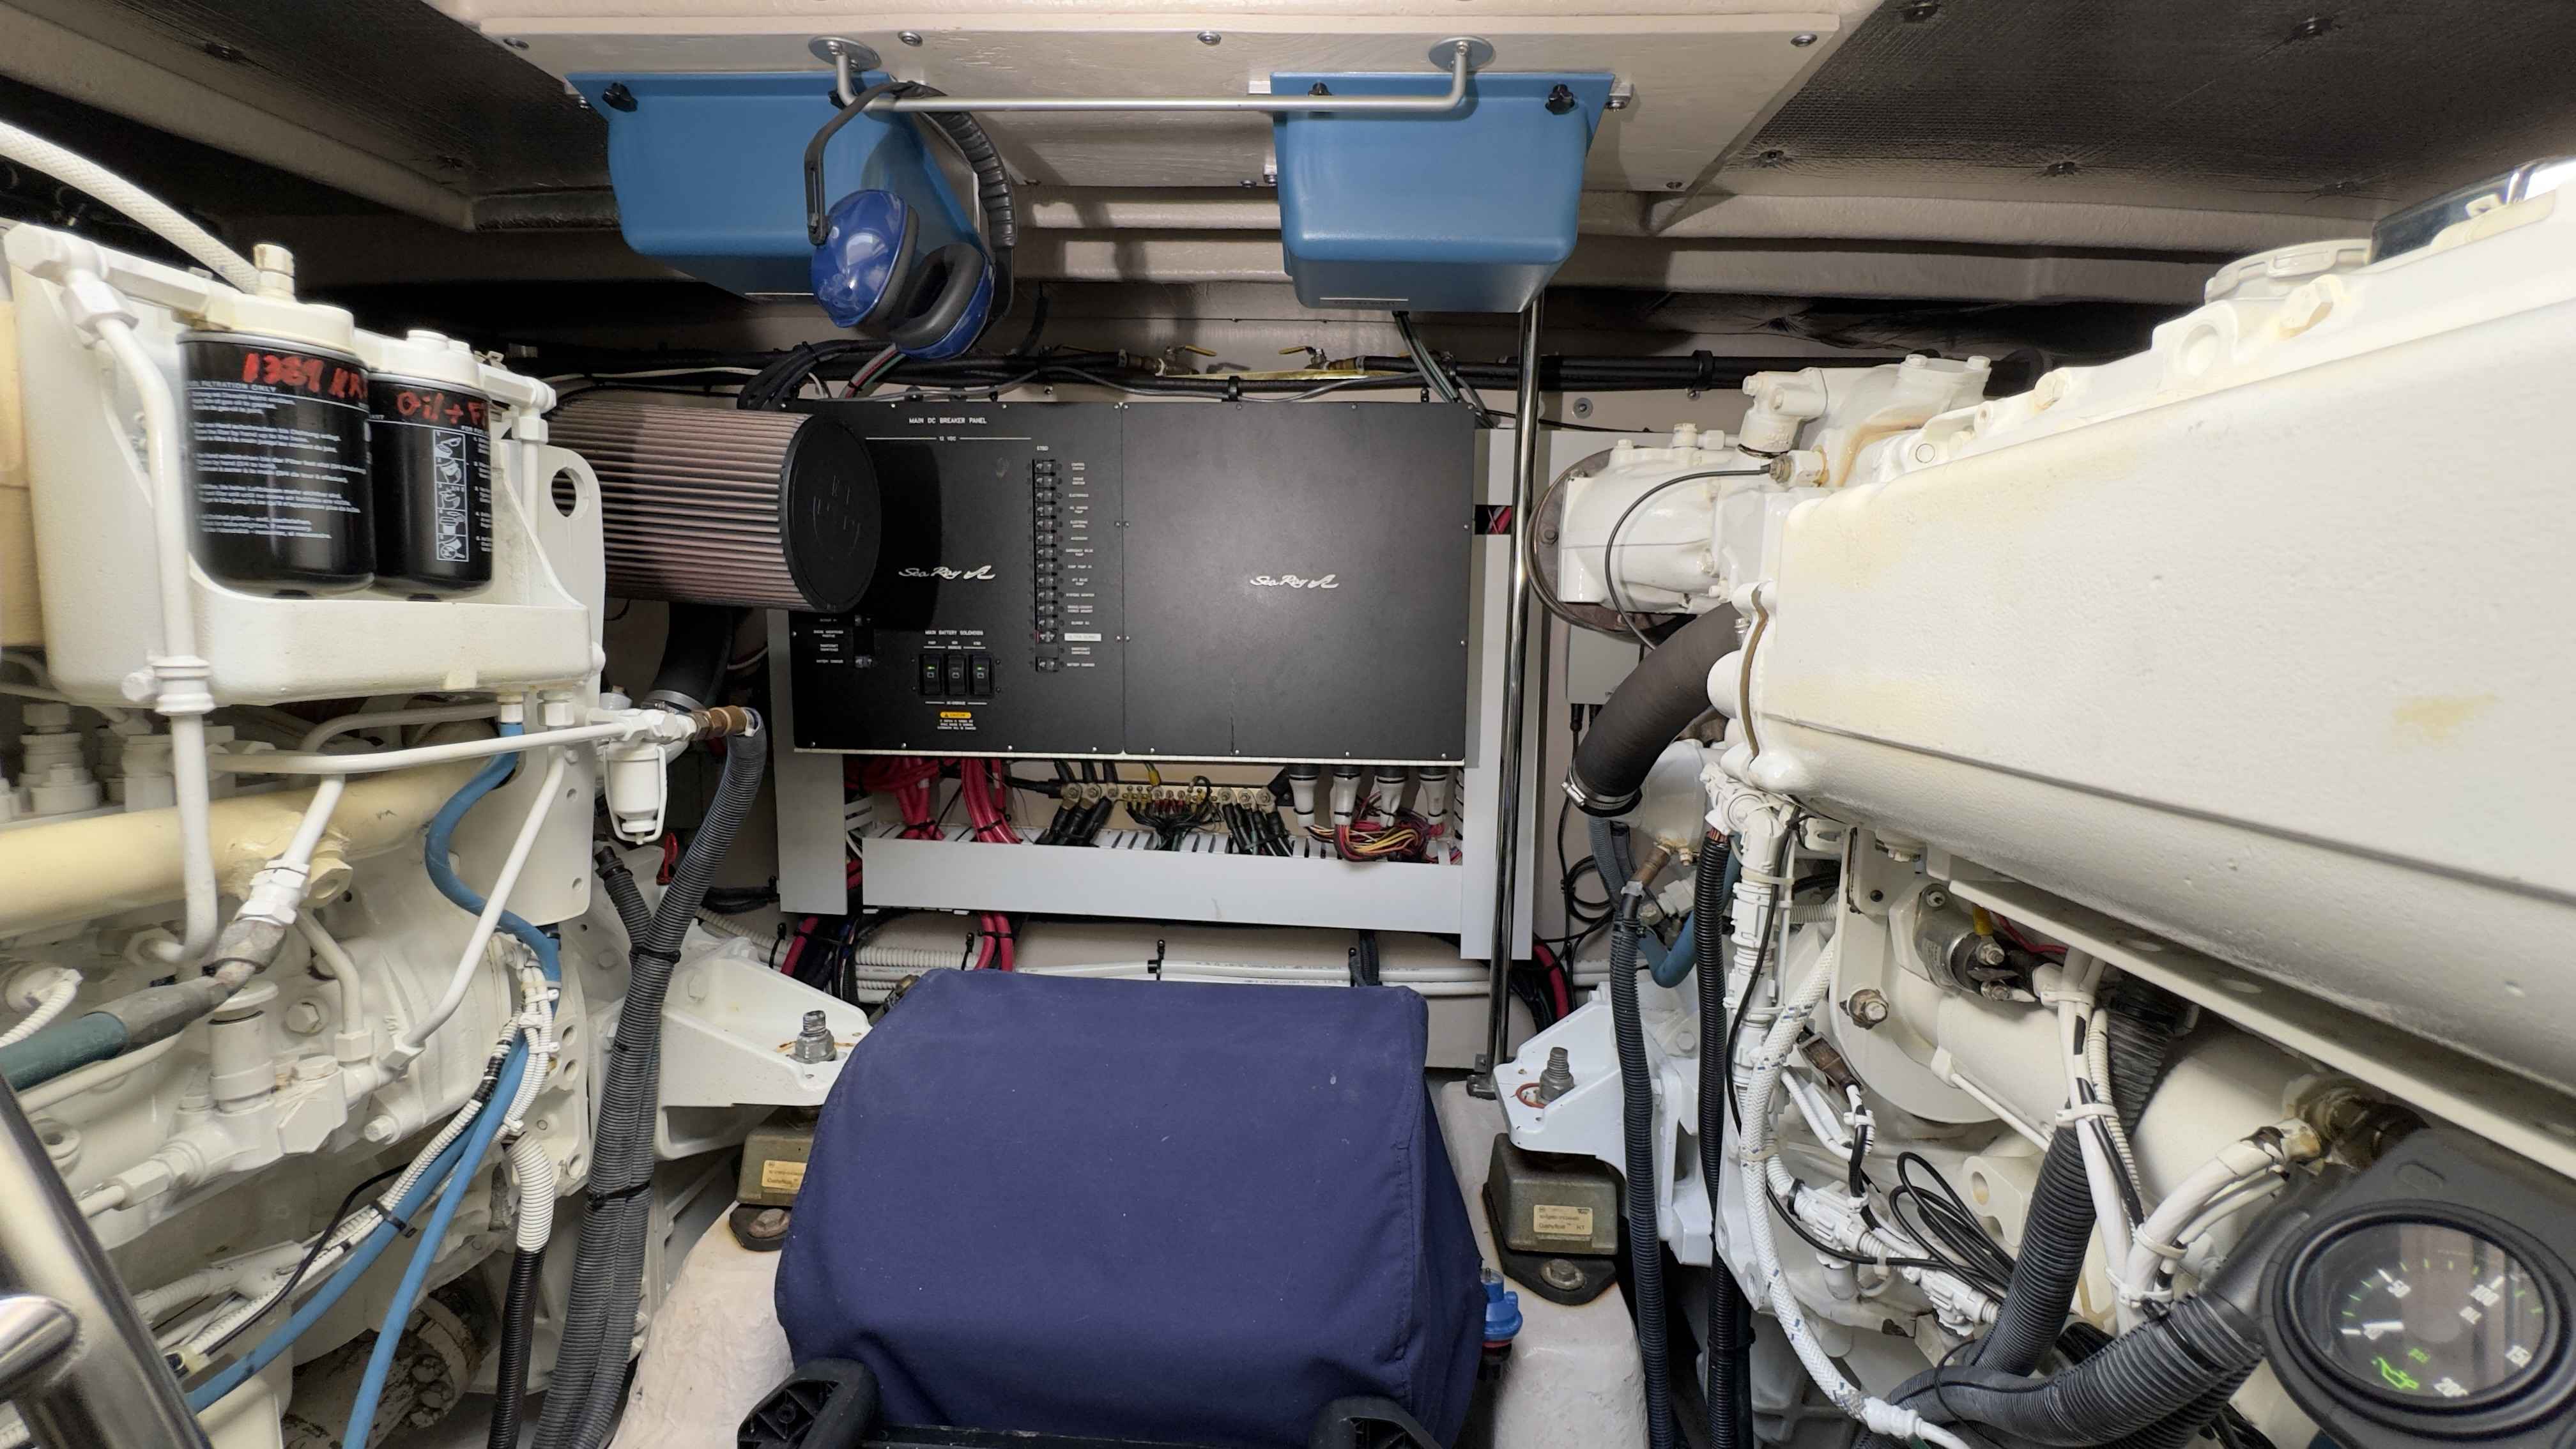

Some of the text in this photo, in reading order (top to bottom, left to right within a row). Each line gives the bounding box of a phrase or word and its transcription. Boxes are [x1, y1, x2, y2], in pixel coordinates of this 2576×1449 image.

[898, 566, 962, 580] Sea Ray
[1250, 574, 1309, 588] Sea Ray
